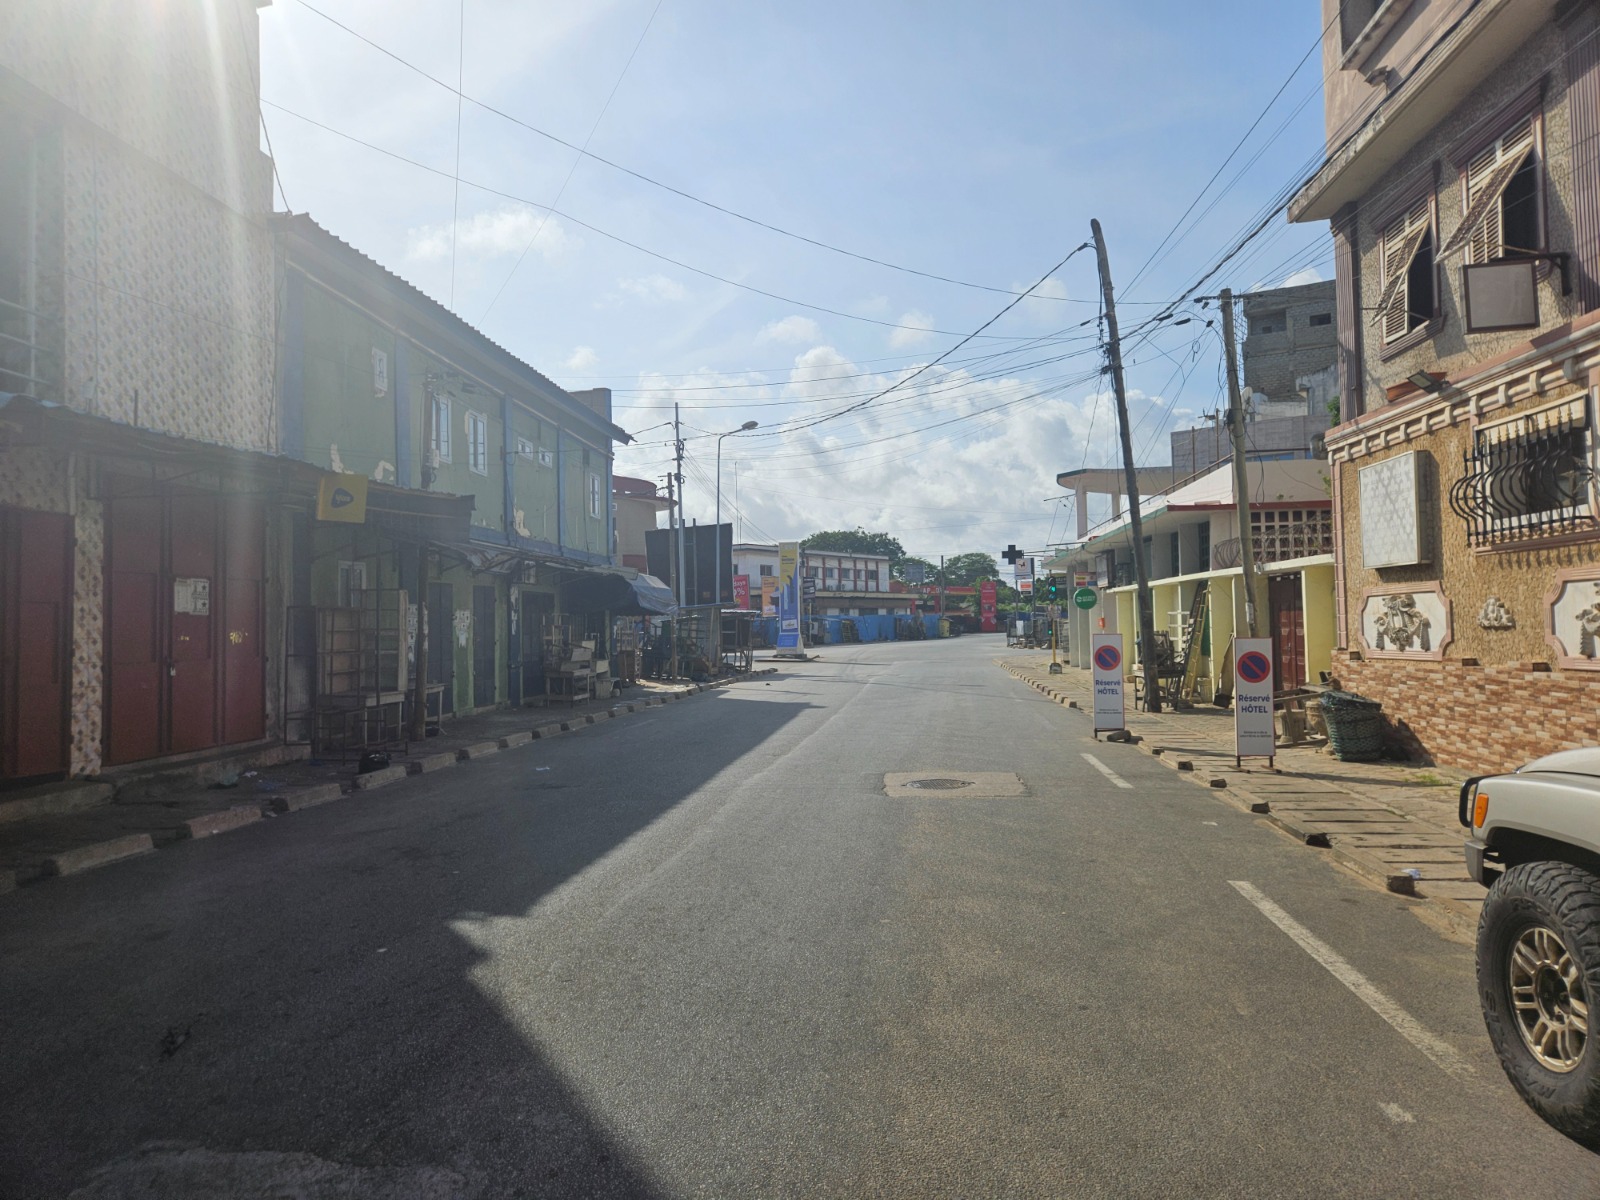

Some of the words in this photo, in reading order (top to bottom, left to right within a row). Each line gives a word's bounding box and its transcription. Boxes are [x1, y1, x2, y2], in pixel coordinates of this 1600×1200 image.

[1097, 687, 1119, 695] HÔTEL
[1238, 694, 1271, 702] Réservé
[1241, 704, 1268, 713] HÔTEL
